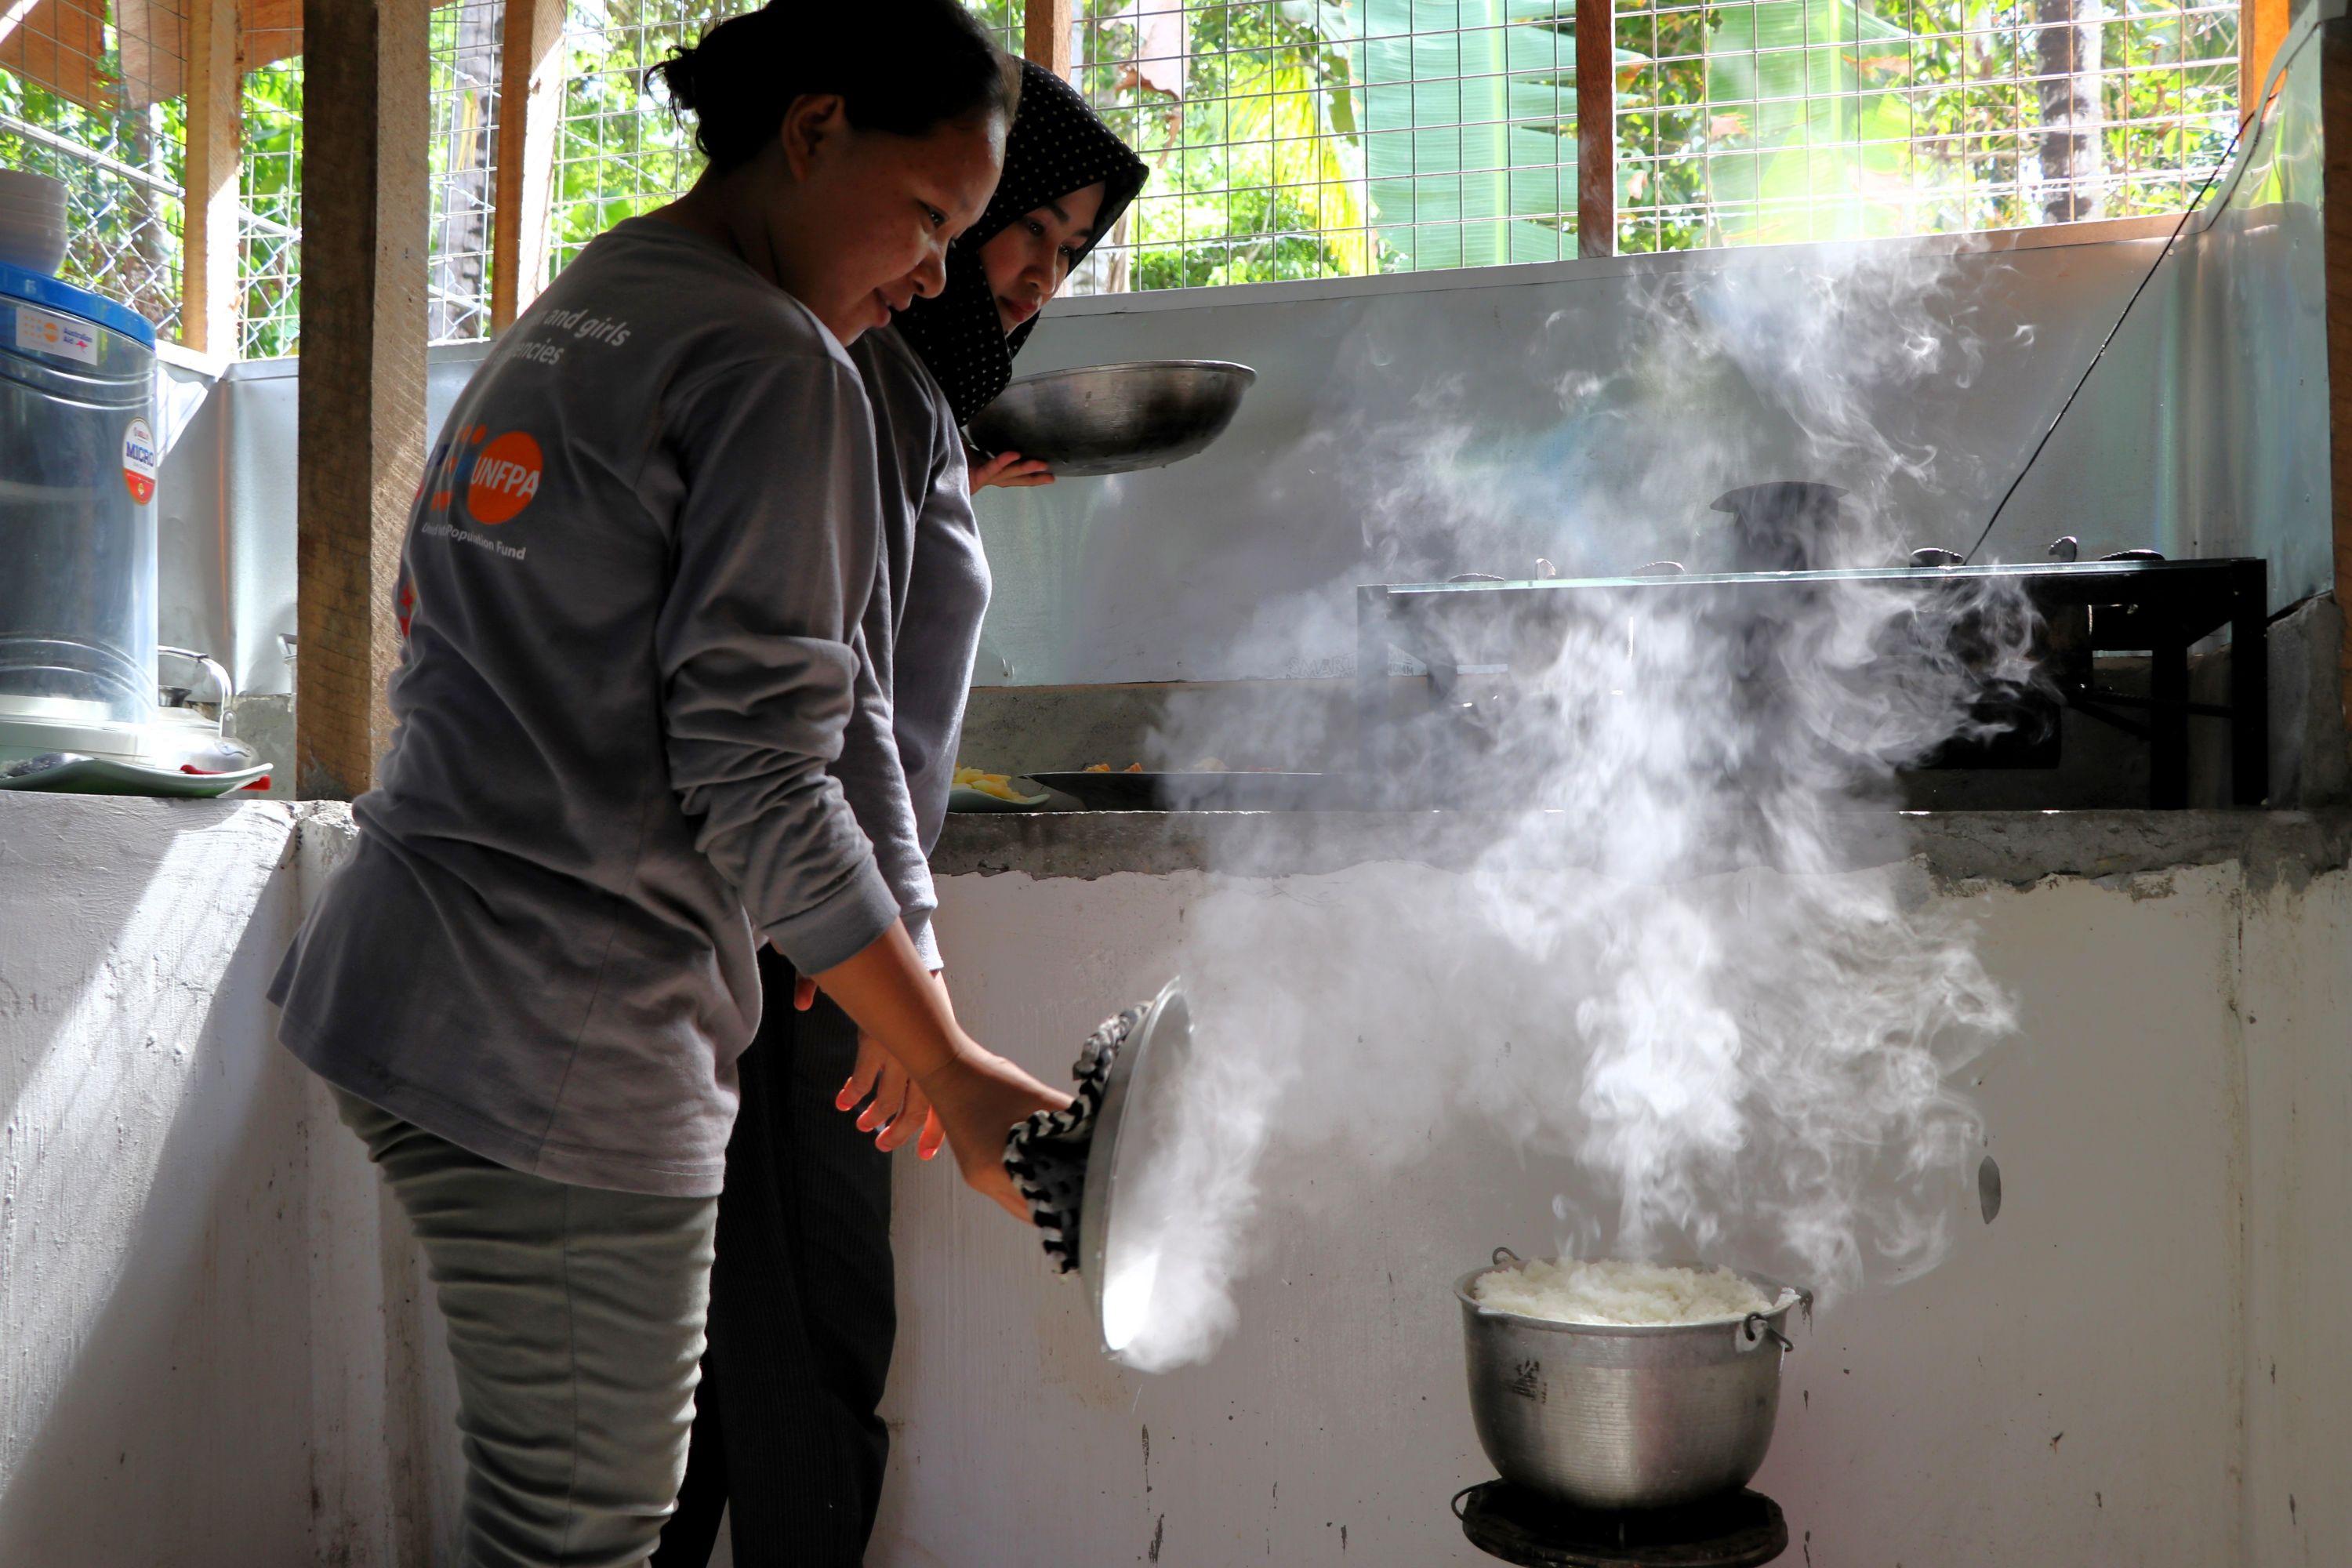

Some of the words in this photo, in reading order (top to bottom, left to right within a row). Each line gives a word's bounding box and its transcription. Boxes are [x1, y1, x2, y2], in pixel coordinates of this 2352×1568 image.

[544, 308, 590, 329] and
[574, 316, 632, 347] girls
[126, 441, 154, 466] MICRO
[470, 455, 540, 499] UNFPA
[496, 540, 527, 561] Fund
